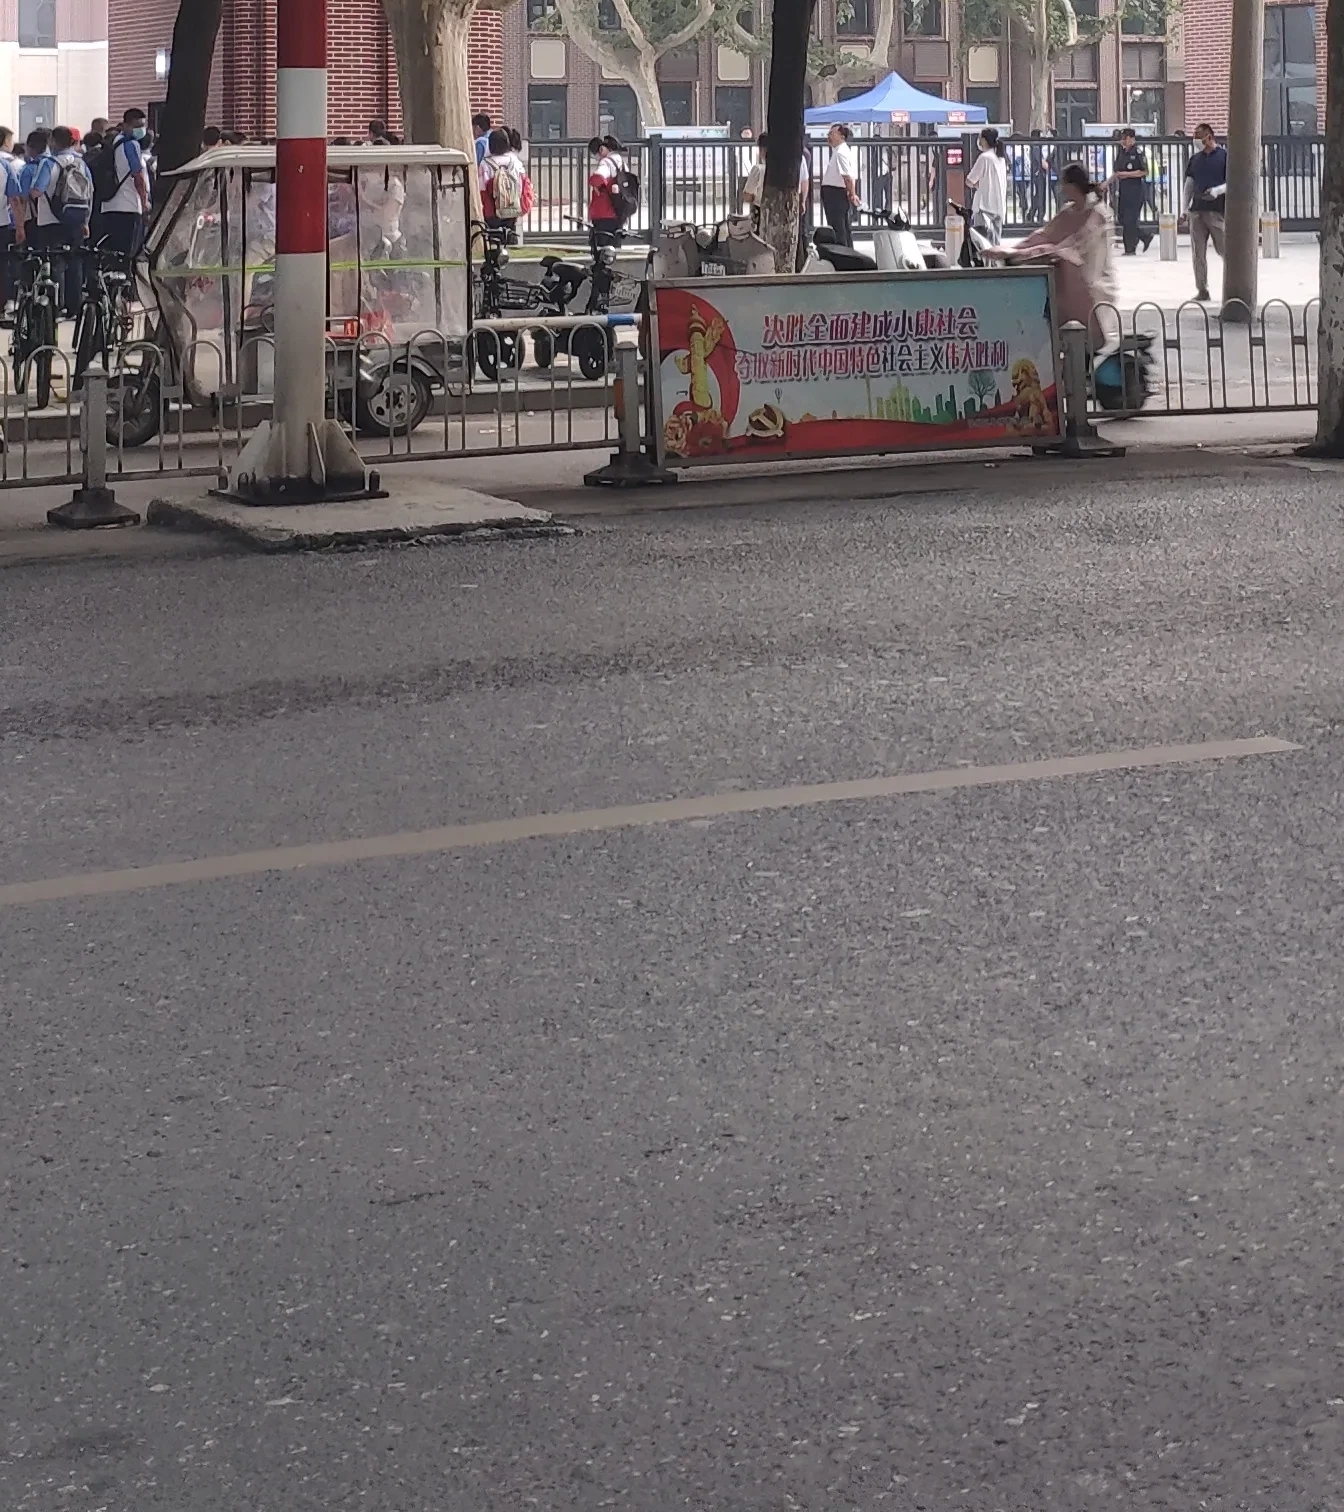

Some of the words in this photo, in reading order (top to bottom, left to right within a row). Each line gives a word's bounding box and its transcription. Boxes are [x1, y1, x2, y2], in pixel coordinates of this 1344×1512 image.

[761, 306, 978, 346] 决胜全面建成小康社会
[737, 340, 1008, 382] 夺取新时代中国特色社会主义伟大胜利
